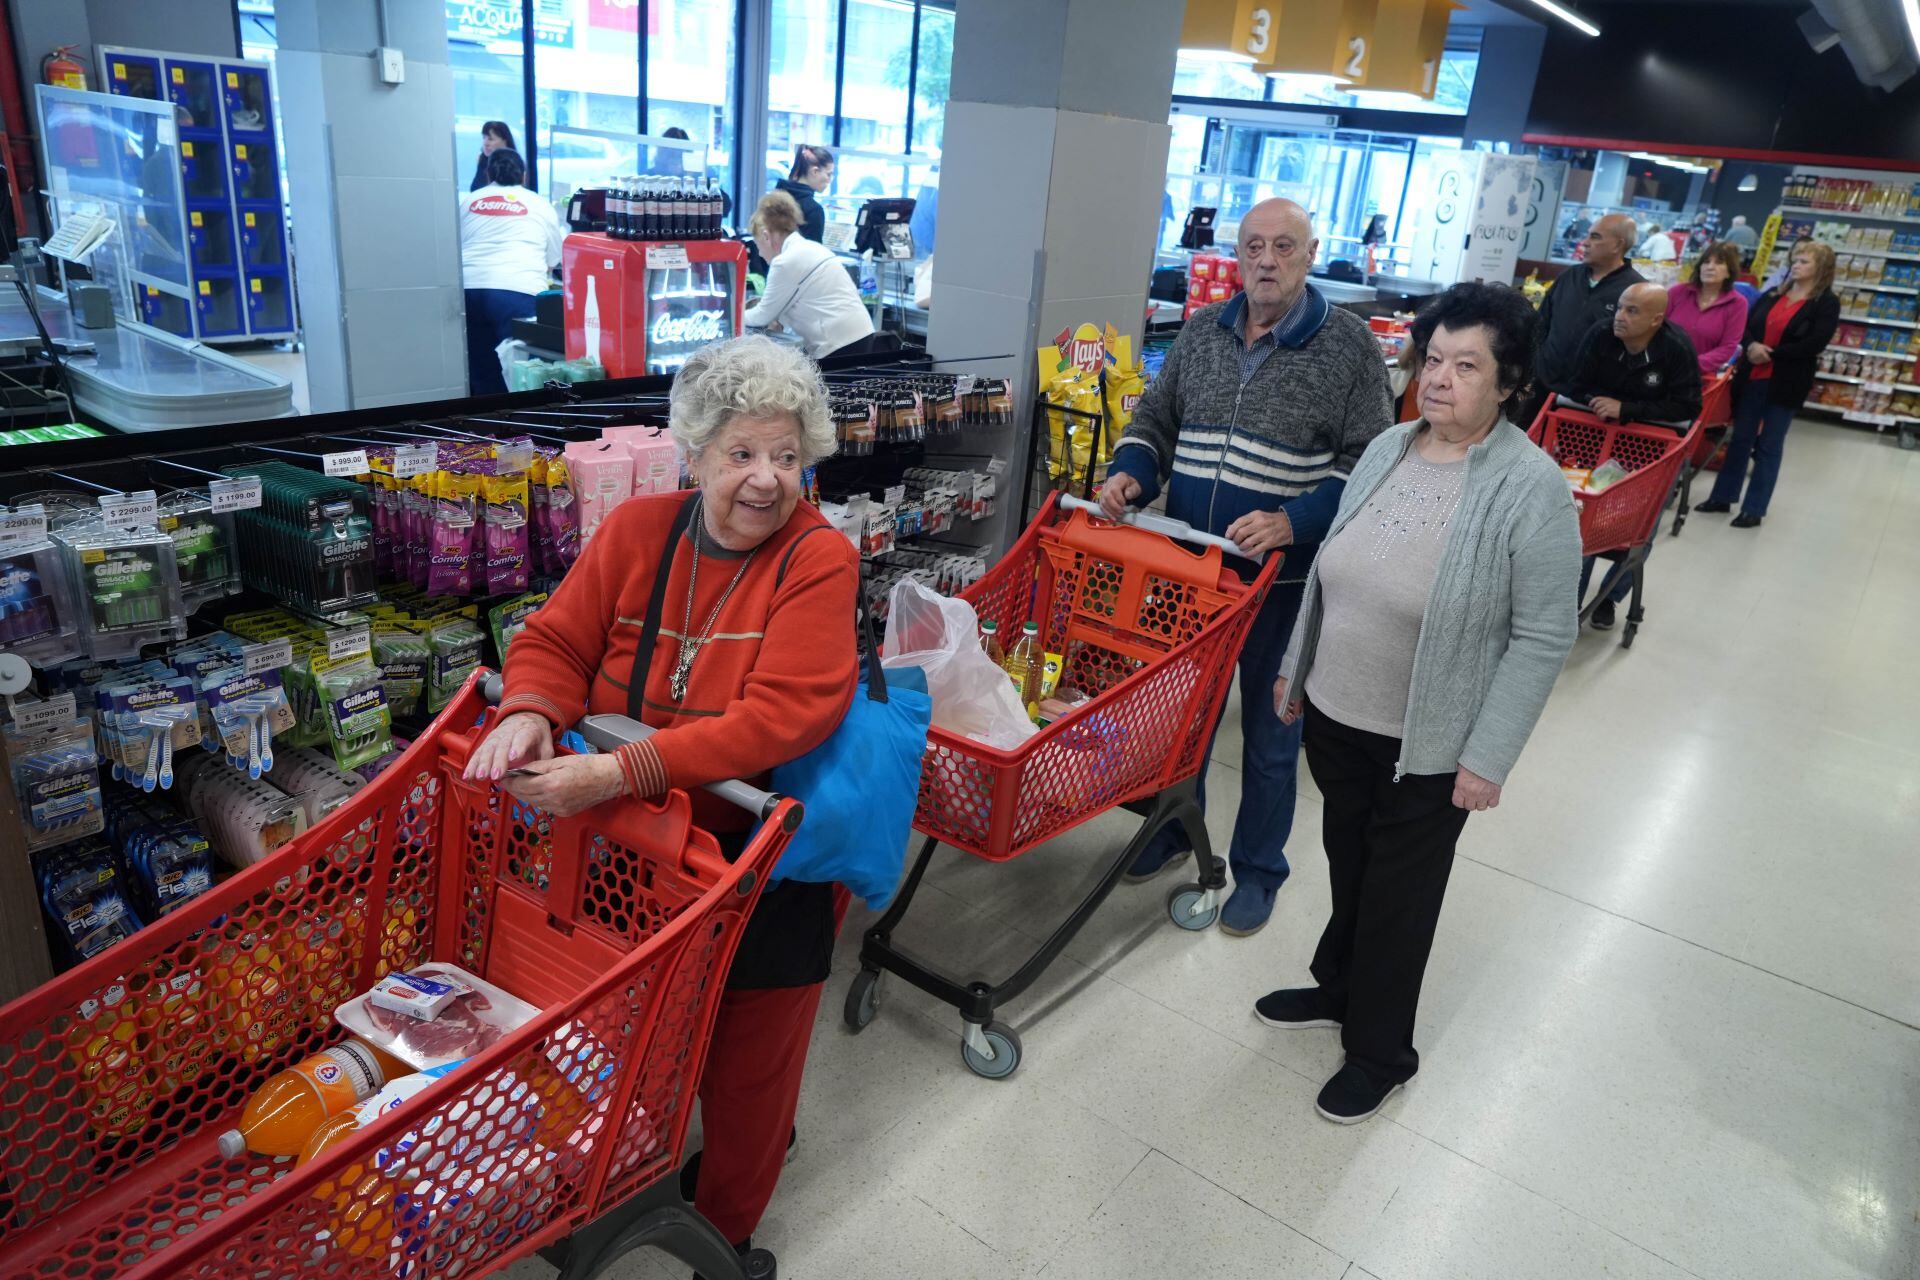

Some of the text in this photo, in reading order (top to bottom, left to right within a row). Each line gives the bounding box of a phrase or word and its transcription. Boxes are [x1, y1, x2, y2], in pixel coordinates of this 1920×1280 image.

[1247, 8, 1272, 54] 3
[1345, 37, 1366, 77] 2
[1423, 58, 1437, 94] 1
[471, 200, 525, 213] Josimar
[653, 310, 724, 344] Coca-Cola
[1073, 340, 1104, 373] Lay's
[338, 455, 362, 465] 999.00
[226, 491, 256, 501] 1199.00
[110, 505, 153, 518] $ 2299.00
[870, 512, 895, 532] Energizer
[323, 540, 369, 557] Gillette
[431, 553, 470, 564] Comfort
[487, 553, 525, 567] Comfort
[94, 560, 153, 577] Gillette
[261, 651, 285, 663] 699.00
[446, 648, 478, 664] Gillette
[383, 664, 421, 673] Gillette
[219, 678, 261, 696] Gillette
[127, 691, 175, 705] Gillette
[342, 689, 381, 709] Gillette
[25, 707, 69, 722] $ 1099.00
[37, 772, 91, 794] Gillette
